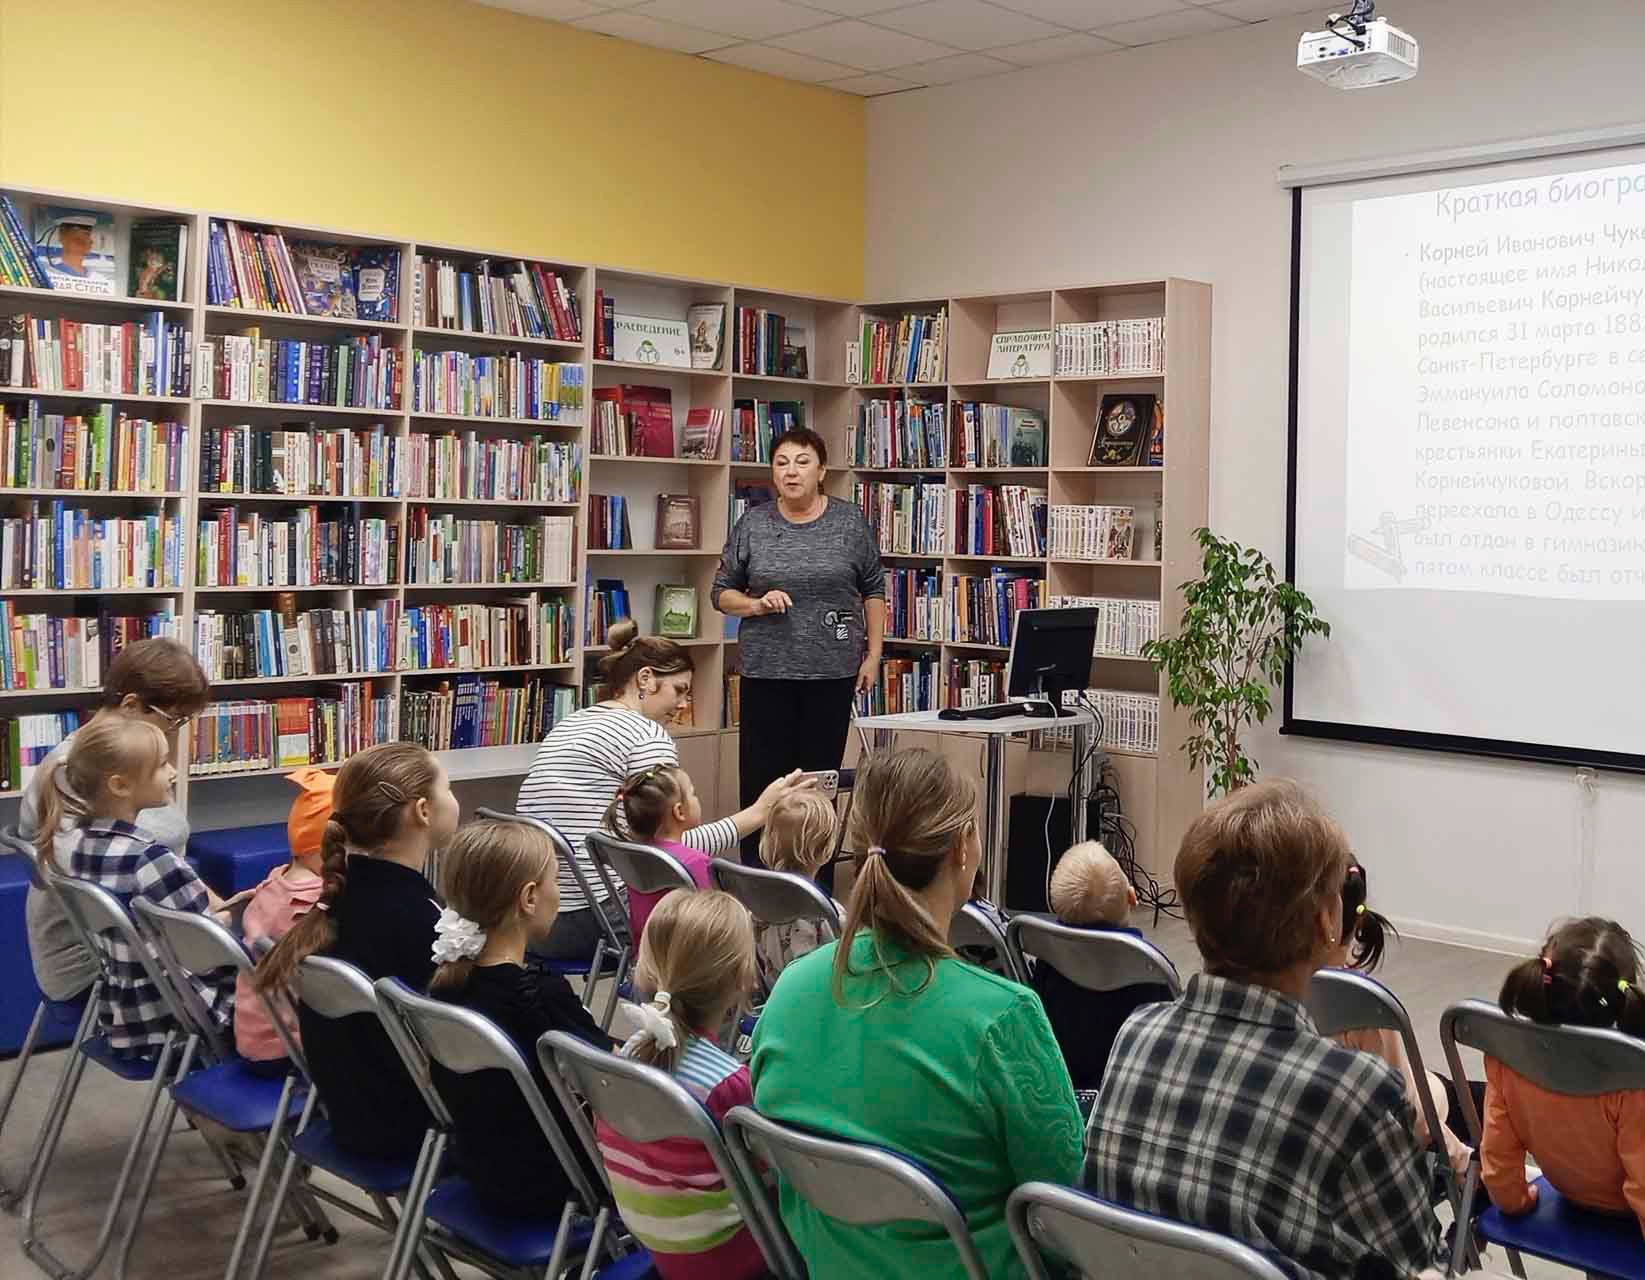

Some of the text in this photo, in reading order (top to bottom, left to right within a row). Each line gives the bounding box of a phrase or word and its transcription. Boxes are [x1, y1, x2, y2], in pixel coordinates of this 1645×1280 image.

[1436, 176, 1645, 223] Краткая биогра
[1419, 239, 1488, 264] Корней
[1498, 232, 1594, 255] Иванович
[1419, 269, 1528, 293] (настоящее
[1536, 265, 1577, 279] имя
[1419, 296, 1532, 318] Васильевич
[614, 320, 681, 336] РАЕВЕДЕНИЕ
[1418, 327, 1498, 351] родился
[1508, 322, 1527, 340] 31
[1536, 319, 1594, 343] марта
[1418, 349, 1598, 375] Санкт-Петербурге
[1609, 351, 1618, 365] в
[1528, 416, 1539, 430] и
[1415, 445, 1520, 466] крестьянки
[1528, 507, 1537, 520] в
[1546, 502, 1622, 524] Одессу
[1460, 534, 1516, 549] отдан
[1525, 535, 1534, 550] в
[1481, 561, 1547, 583] классе
[1557, 564, 1600, 584] был
